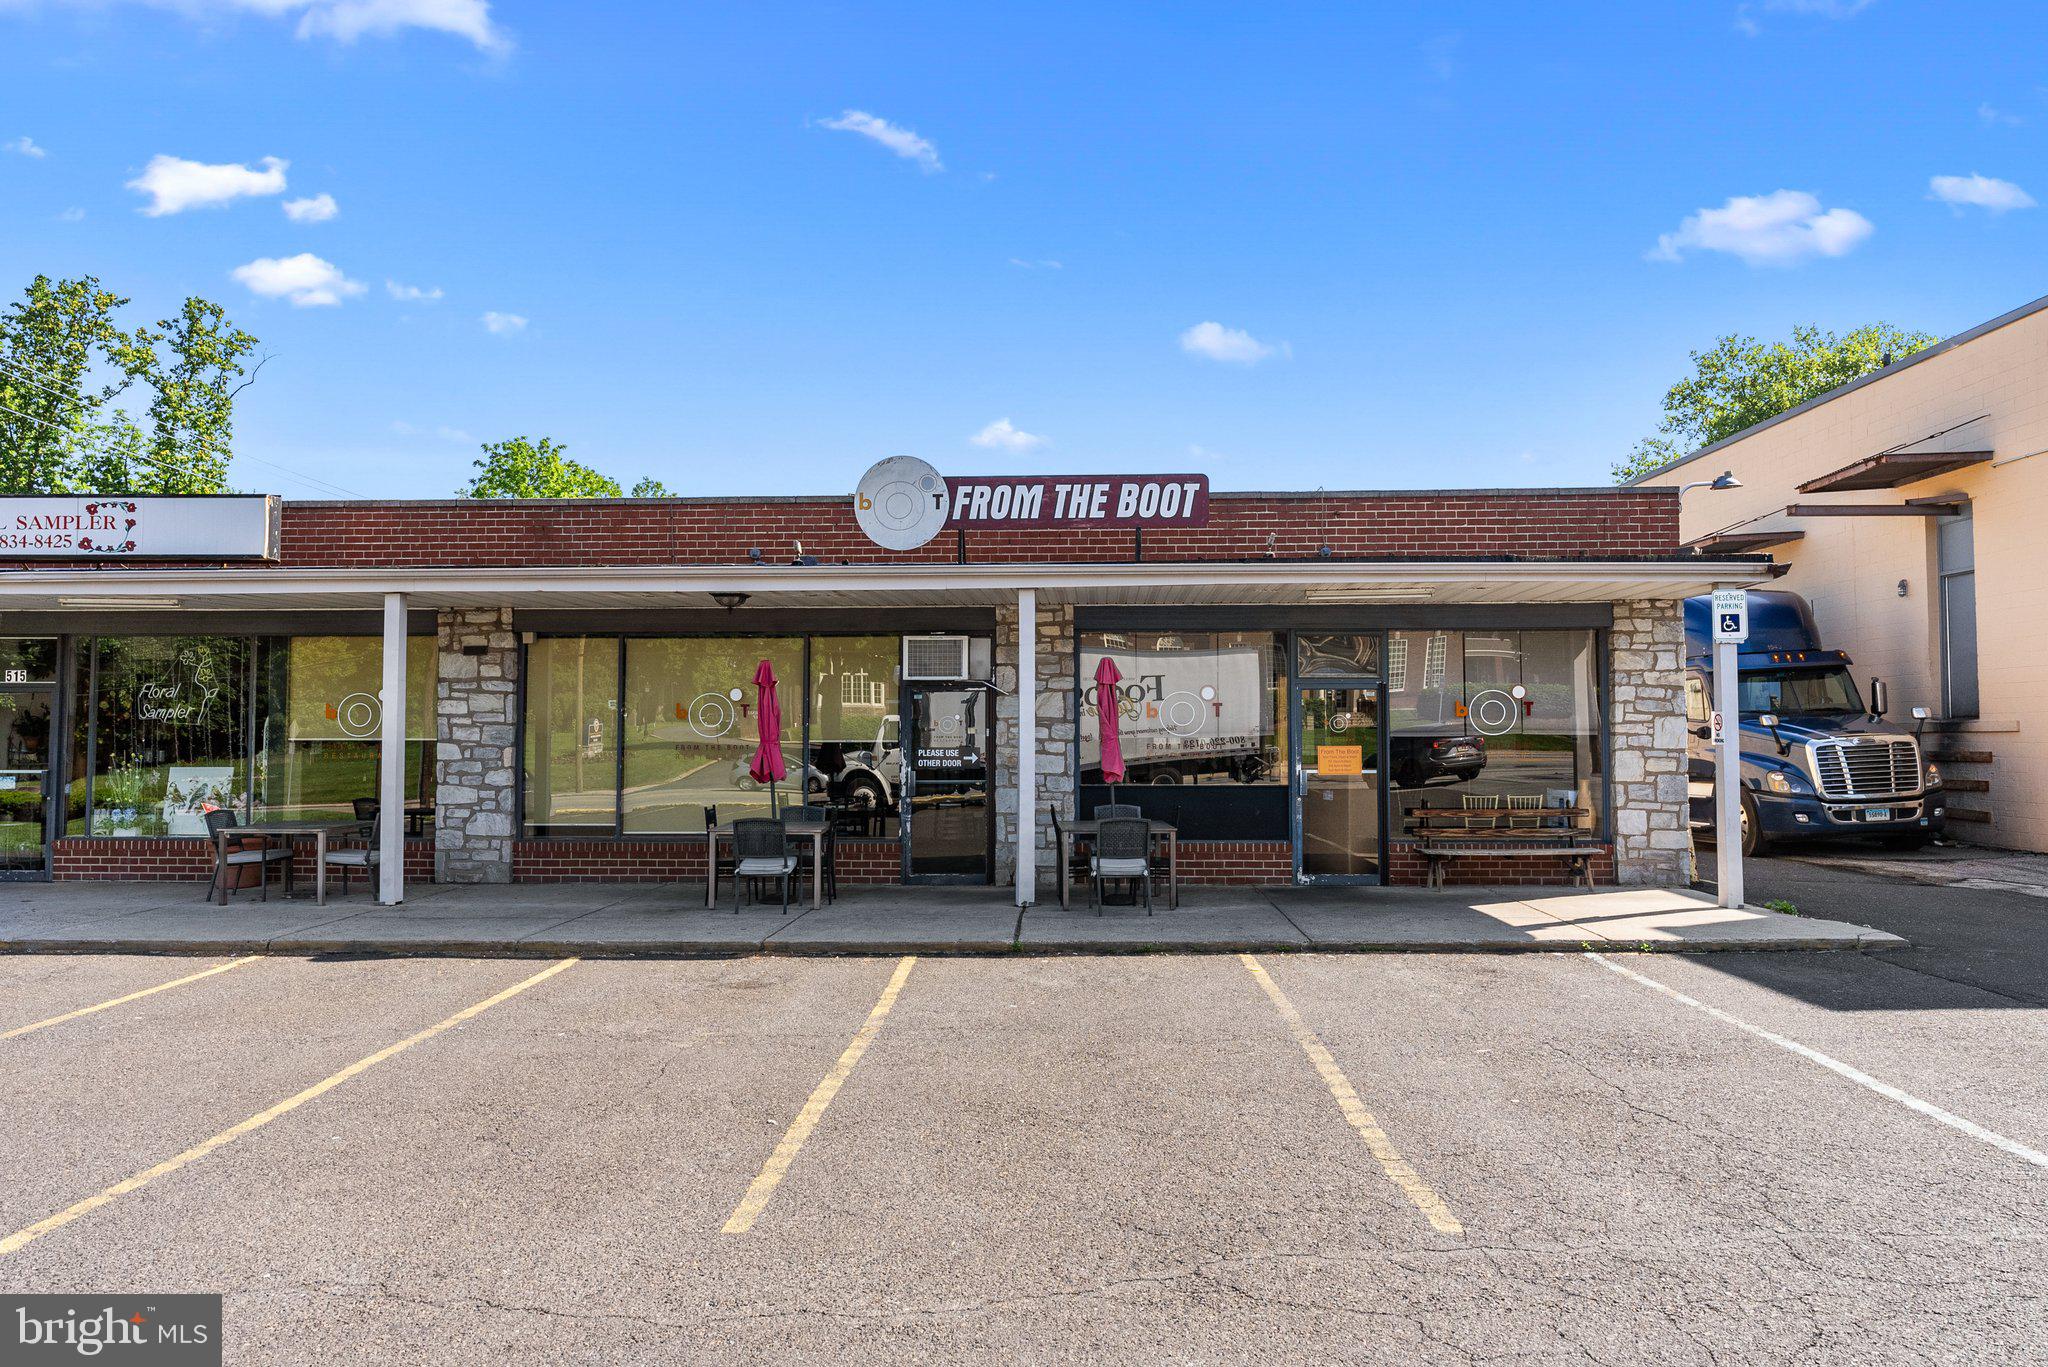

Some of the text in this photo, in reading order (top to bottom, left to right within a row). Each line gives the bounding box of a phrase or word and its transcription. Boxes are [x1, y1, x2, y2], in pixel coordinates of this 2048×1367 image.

[952, 482, 1200, 520] FROM THE BOOT
[16, 515, 117, 530] SAMPLER
[0, 534, 72, 549] 834-8425
[6, 671, 26, 682] 515
[139, 683, 182, 698] Floral
[140, 703, 195, 723] Sampler
[918, 749, 960, 757] PLEASE USE
[917, 759, 962, 767] OTHER DOOR
